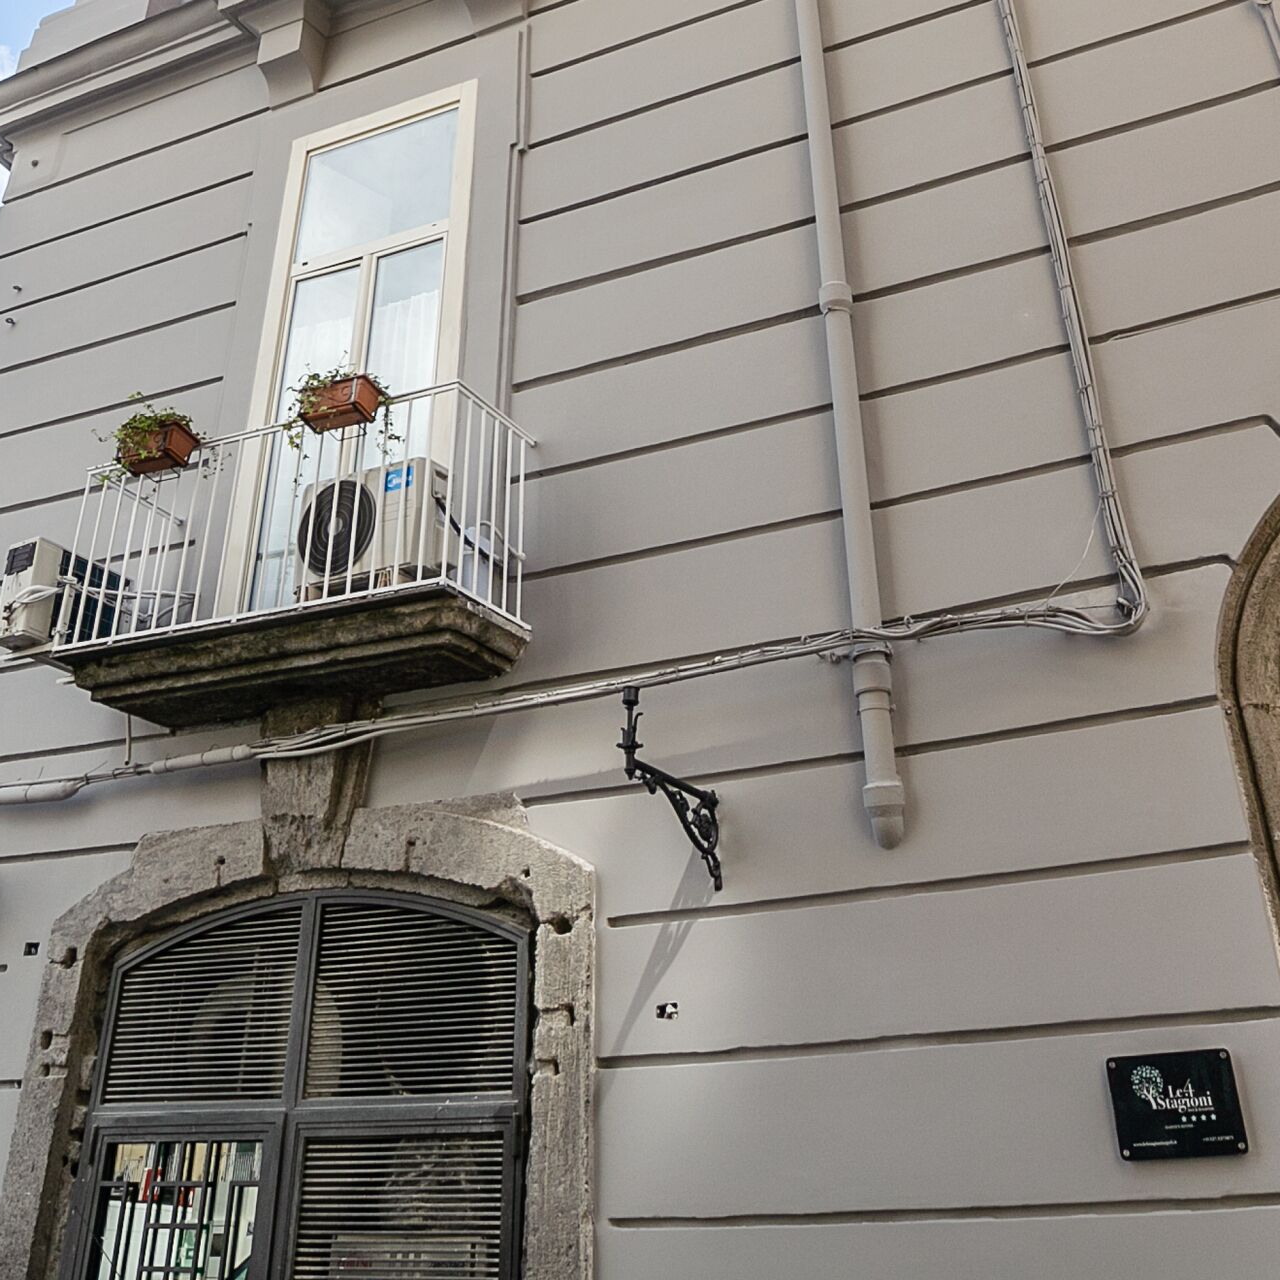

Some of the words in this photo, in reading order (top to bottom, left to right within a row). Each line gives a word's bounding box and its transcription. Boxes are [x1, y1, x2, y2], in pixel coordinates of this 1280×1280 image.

[1167, 1085, 1183, 1099] Le
[1182, 1078, 1195, 1098] 4
[1156, 1090, 1214, 1113] Stagioni
